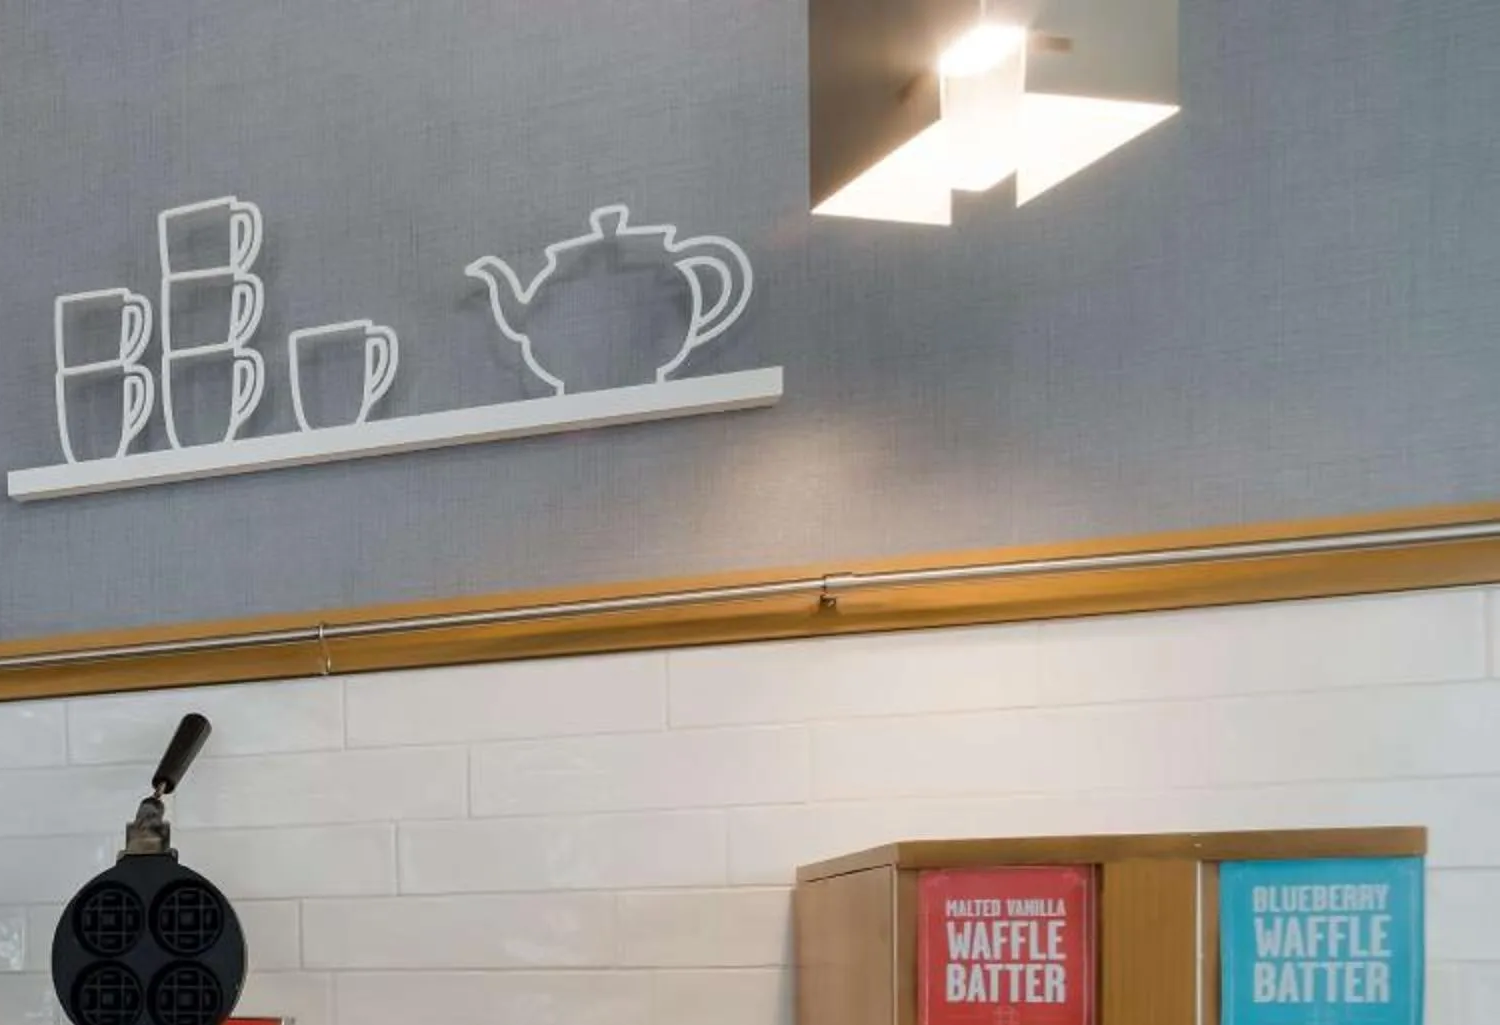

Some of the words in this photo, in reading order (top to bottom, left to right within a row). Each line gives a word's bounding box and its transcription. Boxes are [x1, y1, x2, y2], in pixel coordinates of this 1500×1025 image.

[946, 899, 1001, 917] MALTED
[1007, 899, 1066, 917] VANILLA
[1253, 884, 1389, 912] BLUEBERRY
[946, 920, 1066, 960] WAFFLE
[1254, 914, 1392, 957] WAFFLE
[946, 963, 1066, 1003] BATTER
[1253, 961, 1390, 1002] BATTER
